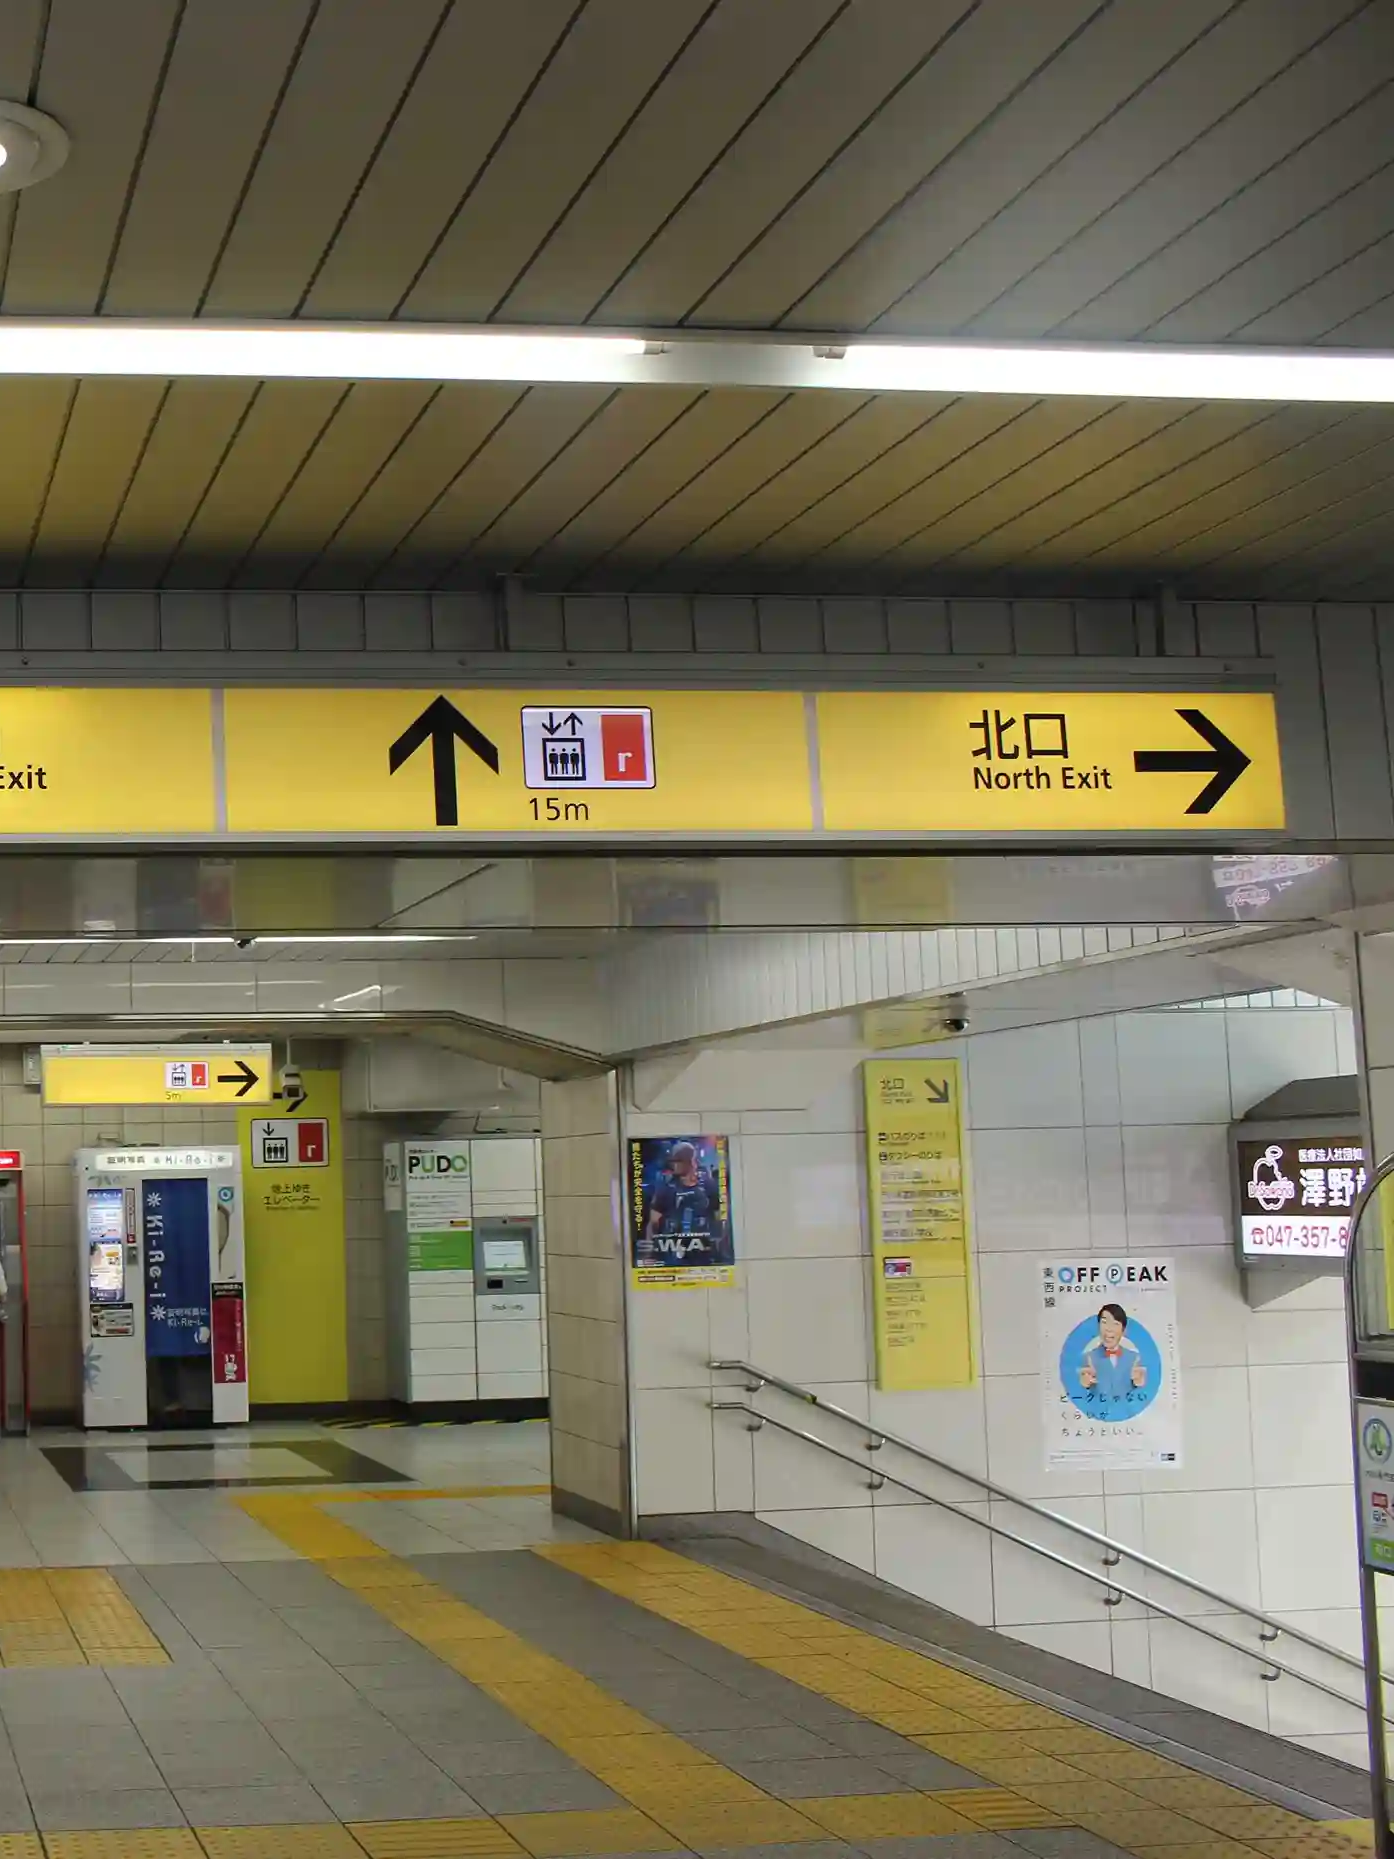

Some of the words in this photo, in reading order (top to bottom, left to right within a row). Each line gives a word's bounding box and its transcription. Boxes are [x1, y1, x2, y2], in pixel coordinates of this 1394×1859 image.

[969, 708, 1069, 760] 北口
[972, 766, 1053, 791] North
[1061, 766, 1112, 791] Exit
[528, 797, 590, 822] 15m
[408, 1154, 468, 1174] PUDO
[263, 1195, 320, 1205] エレベーター
[1058, 1266, 1100, 1284] OFF
[1106, 1264, 1168, 1286] PEAK
[1059, 1284, 1108, 1294] PROJECT
[1059, 1391, 1149, 1403] ピークじゃない
[1060, 1411, 1109, 1421] くらいが
